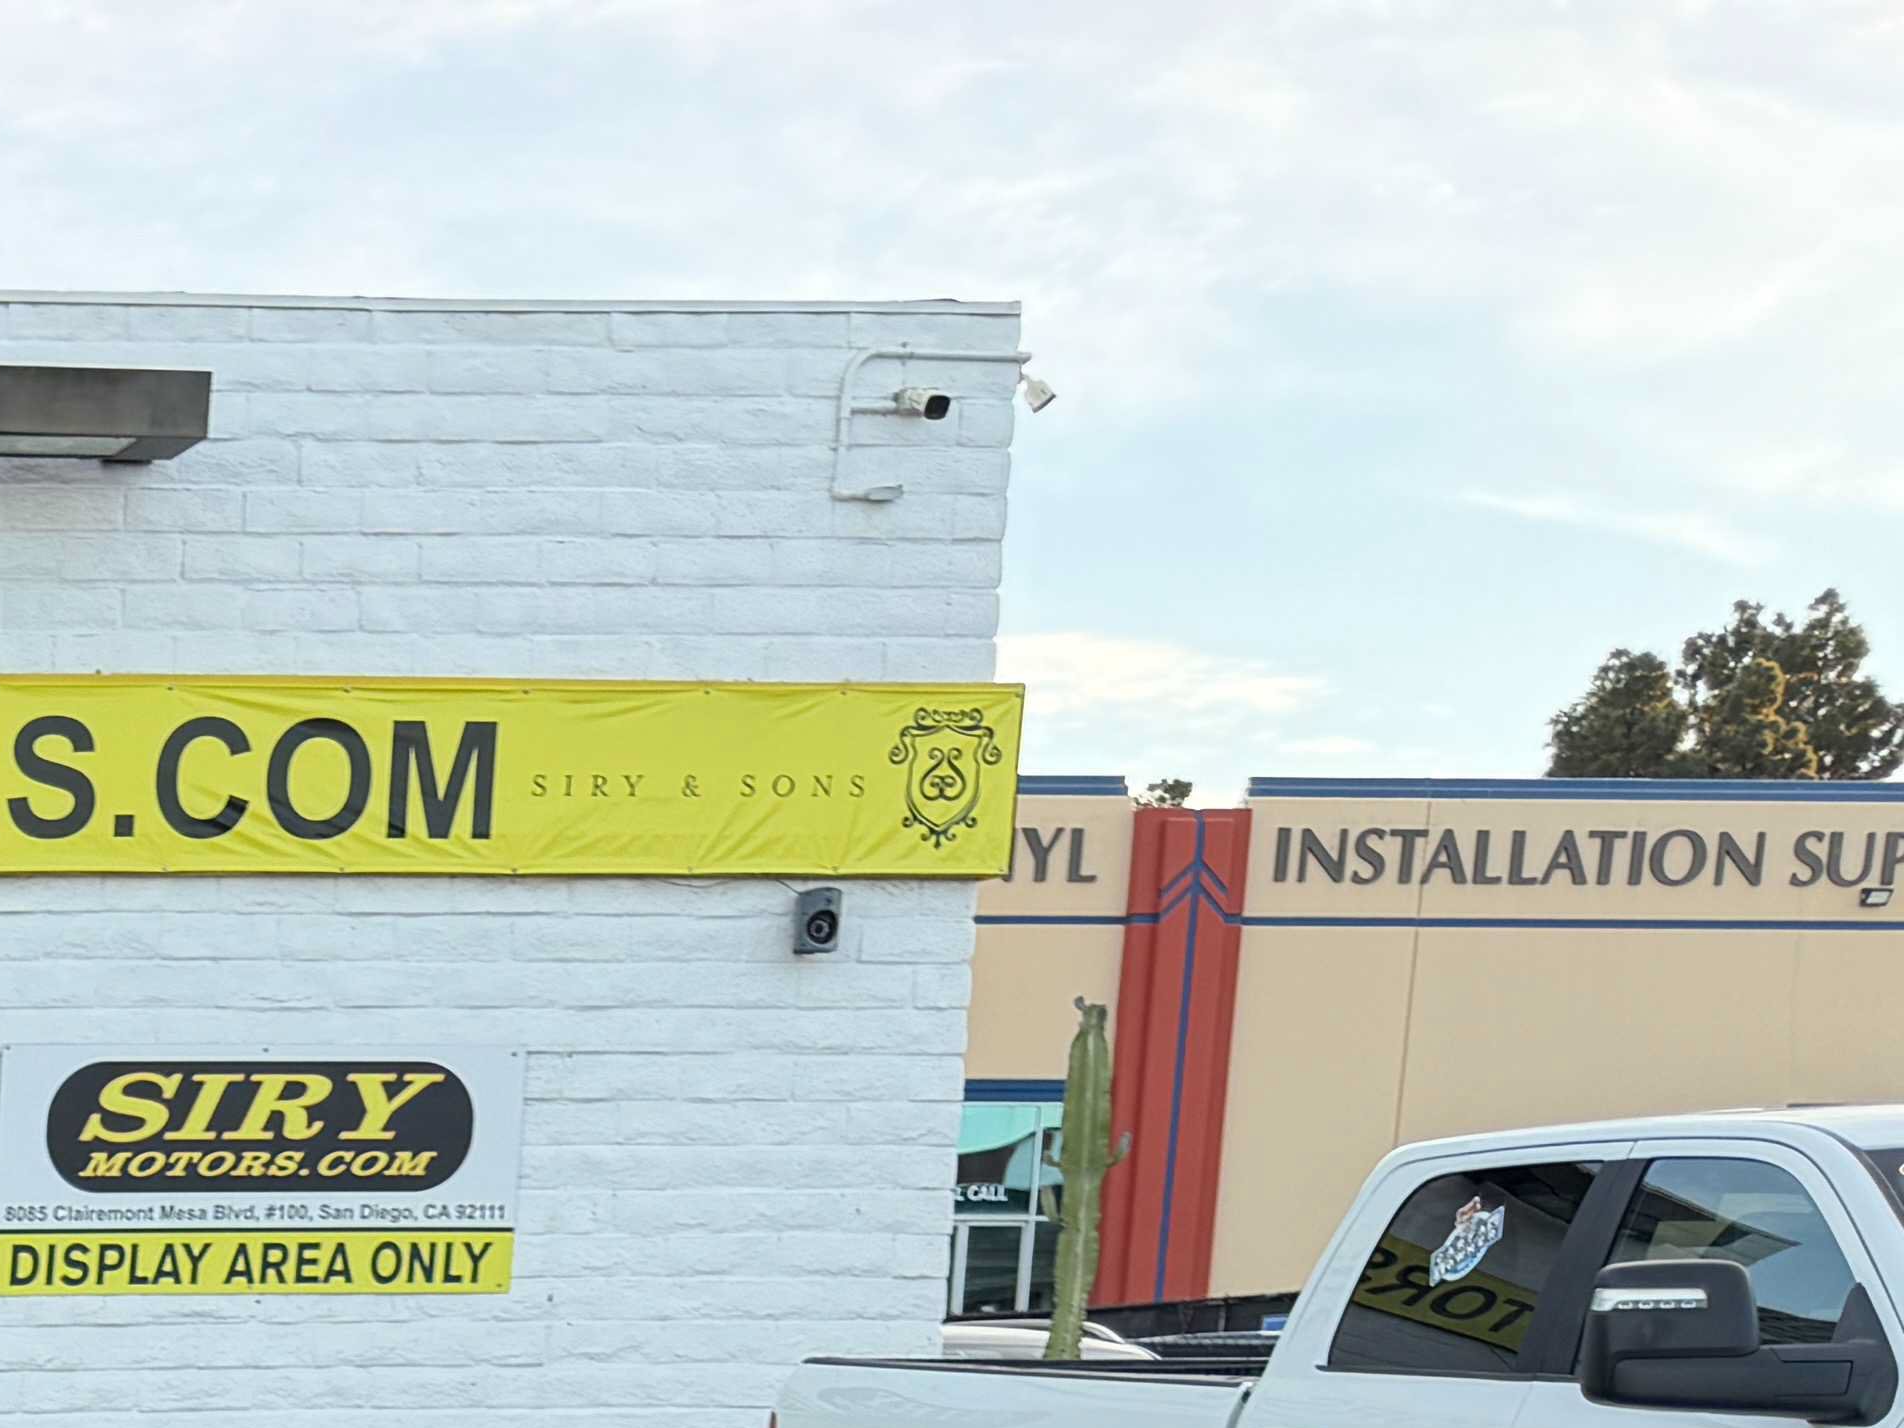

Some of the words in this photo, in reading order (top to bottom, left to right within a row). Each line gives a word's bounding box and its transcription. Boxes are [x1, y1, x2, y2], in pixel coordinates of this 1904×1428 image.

[531, 774, 646, 798] SIRY
[681, 774, 703, 797] &
[740, 774, 866, 798] SONS
[1010, 827, 1097, 883] YL
[1274, 826, 1768, 888] INSTALLATION
[79, 1071, 445, 1144] SIRY
[79, 1150, 437, 1179] MOTORS.COM
[4, 1204, 48, 1222] 8085
[53, 1203, 154, 1222] Clairemont
[159, 1204, 208, 1222] Mesa
[213, 1203, 259, 1224] Blvd,
[264, 1204, 313, 1224] #100,
[319, 1204, 354, 1222] San
[360, 1204, 418, 1225] Diego,
[423, 1204, 452, 1222] CA
[455, 1204, 506, 1221] 92111
[8, 1242, 213, 1287] DISPLAY
[224, 1242, 353, 1286] AREA
[371, 1241, 494, 1285] ONLY
